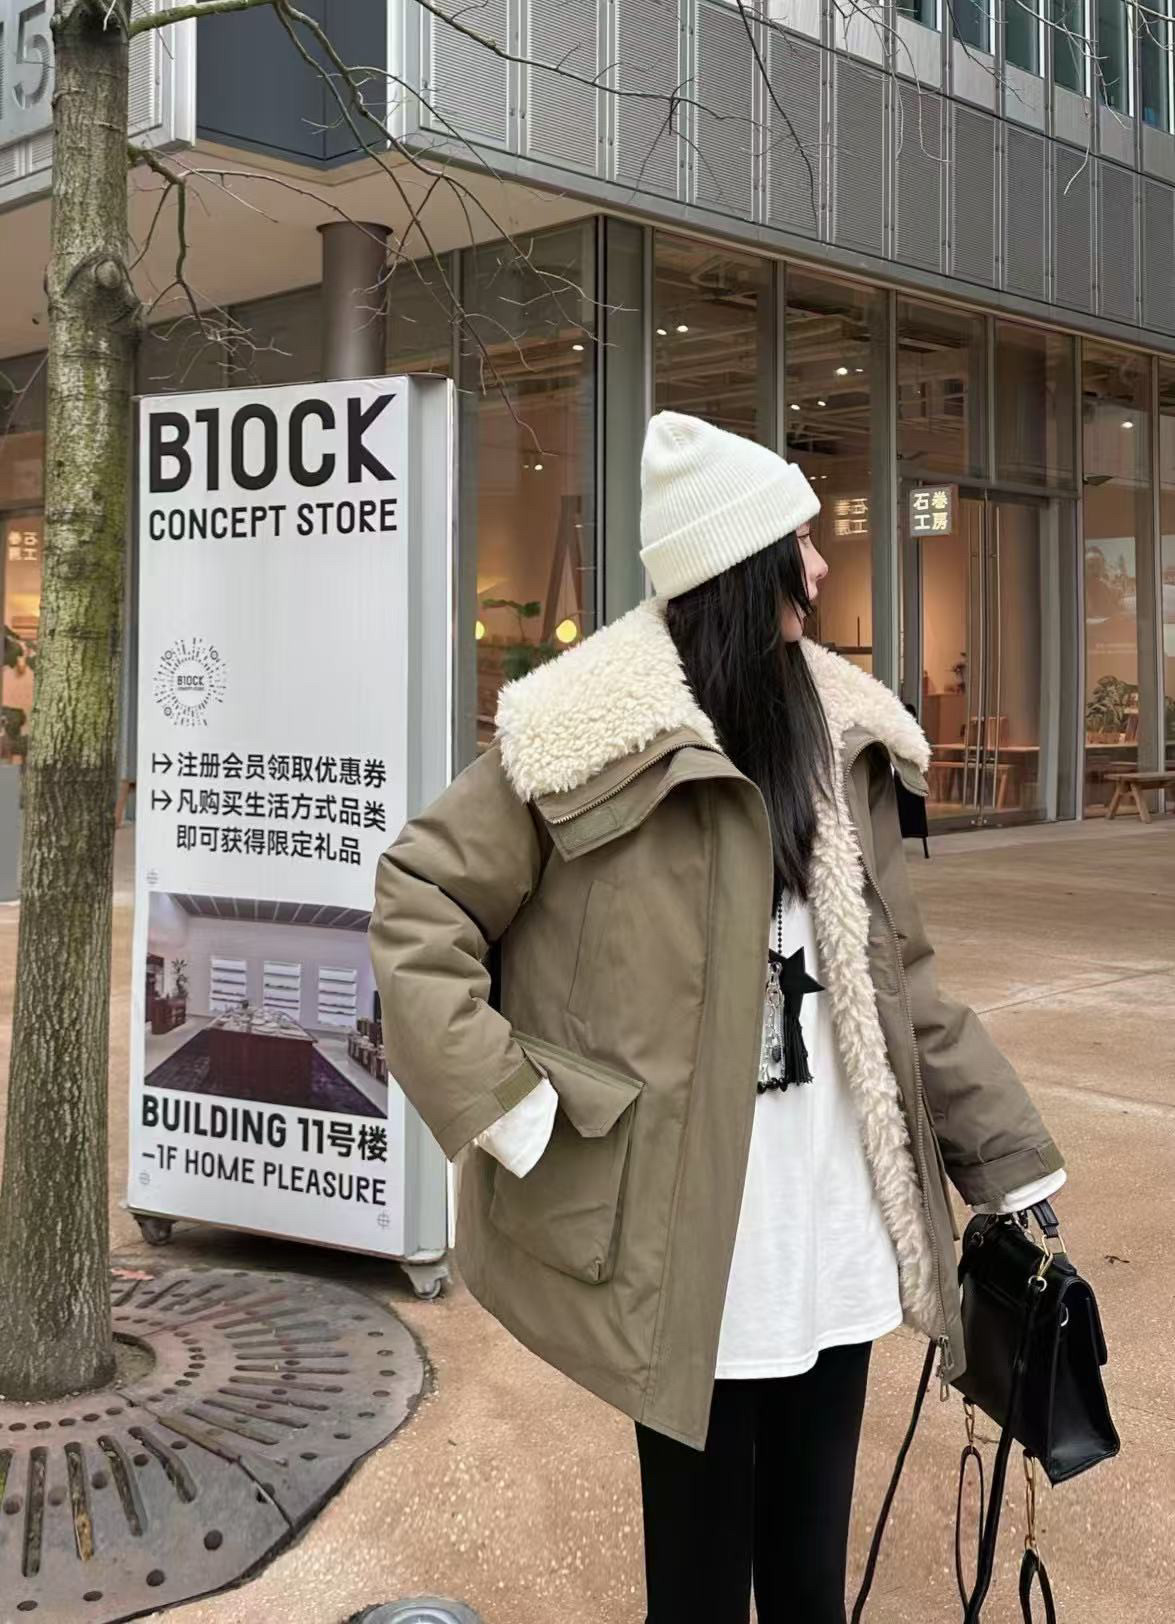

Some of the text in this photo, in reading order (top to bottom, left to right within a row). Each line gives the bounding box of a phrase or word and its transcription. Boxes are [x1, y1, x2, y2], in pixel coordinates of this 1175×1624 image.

[149, 498, 398, 541] CONCEPT STORE
[914, 512, 948, 530] 工房
[177, 751, 387, 789] 注册会员领取优惠券
[176, 788, 387, 833] 凡购买生活方式品类
[176, 824, 362, 866] 即可获得限定礼品
[142, 1094, 389, 1163] BUILDING 11号楼
[185, 1148, 255, 1185] HOME
[263, 1161, 387, 1207] PLEASURE
